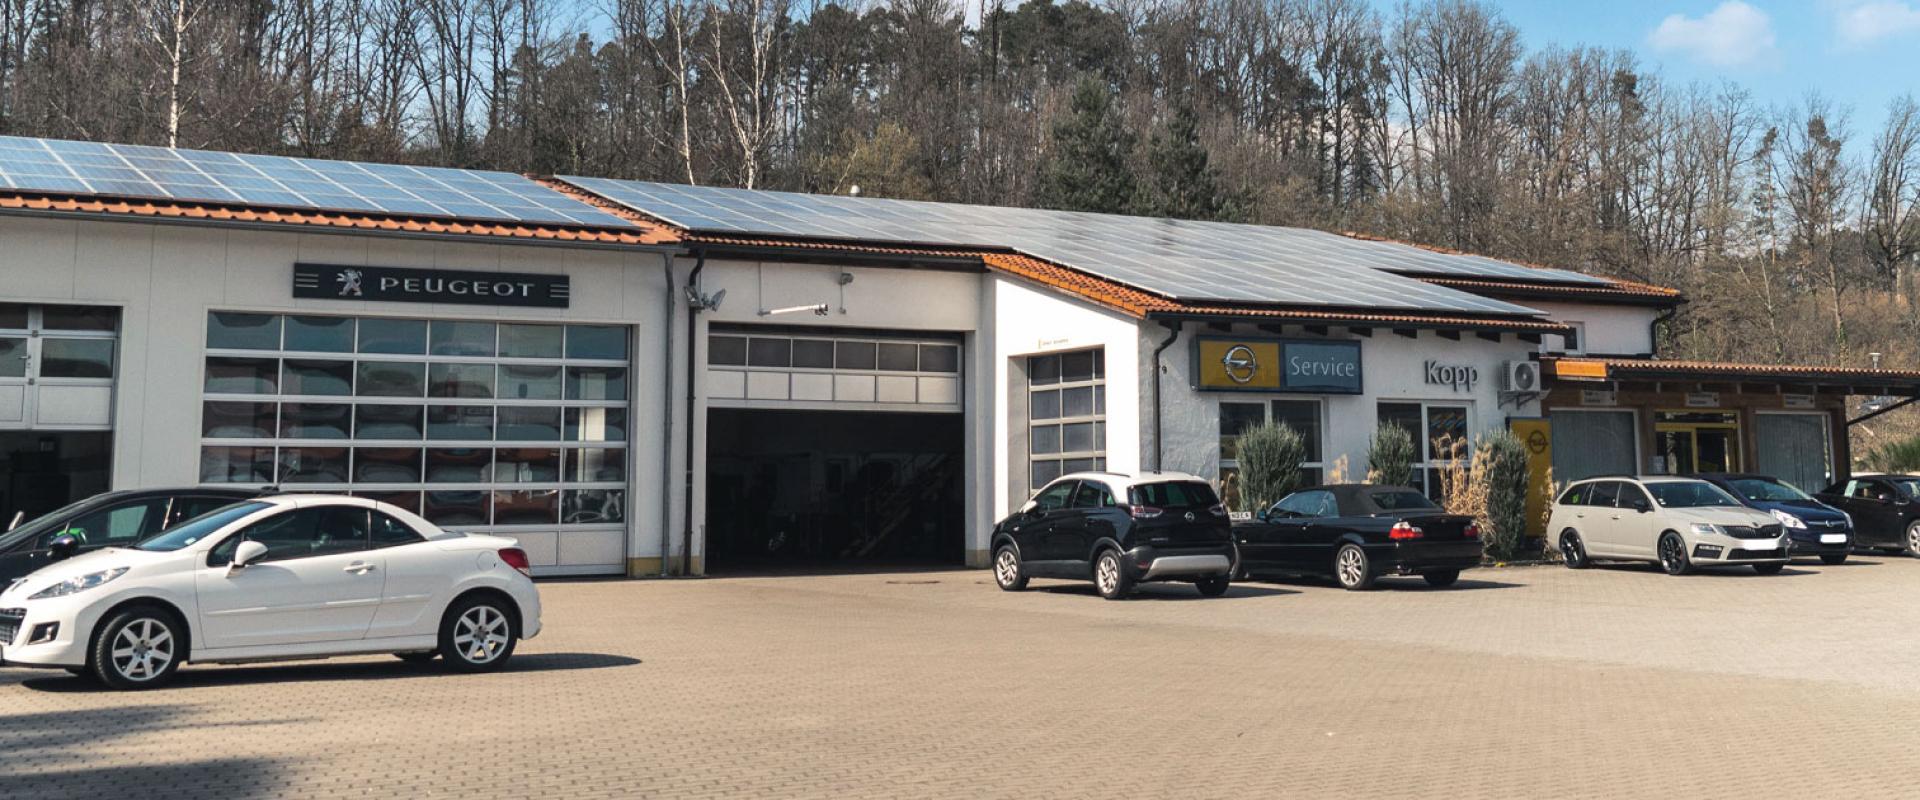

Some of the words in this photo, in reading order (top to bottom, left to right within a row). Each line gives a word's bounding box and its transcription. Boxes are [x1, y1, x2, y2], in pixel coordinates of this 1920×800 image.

[380, 277, 535, 297] PEUGEOT
[1290, 356, 1355, 377] Service
[1424, 360, 1479, 391] Kopp
